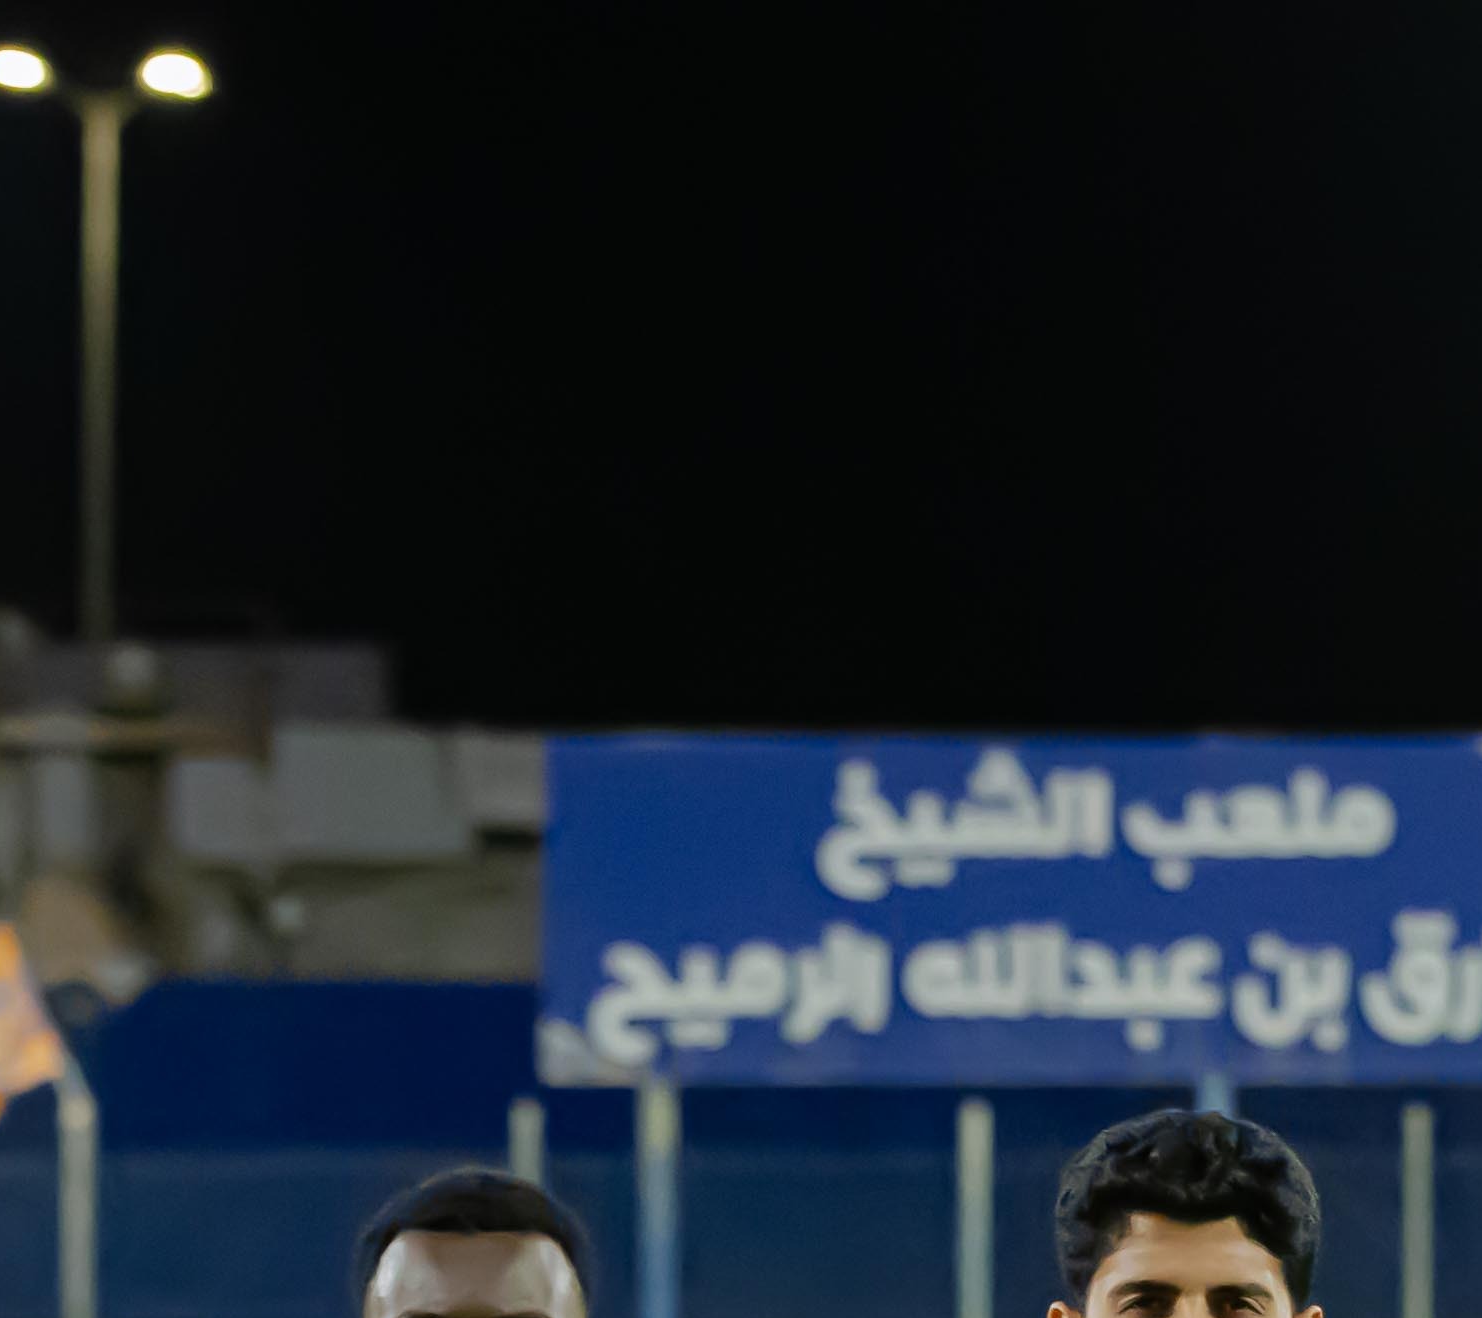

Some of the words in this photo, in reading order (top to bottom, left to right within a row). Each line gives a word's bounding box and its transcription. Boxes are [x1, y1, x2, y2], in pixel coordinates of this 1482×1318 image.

[815, 747, 1114, 901] الشيخ
[1121, 765, 1396, 892] ملعب
[586, 921, 893, 1068] الرميح
[1231, 930, 1352, 1052] بن
